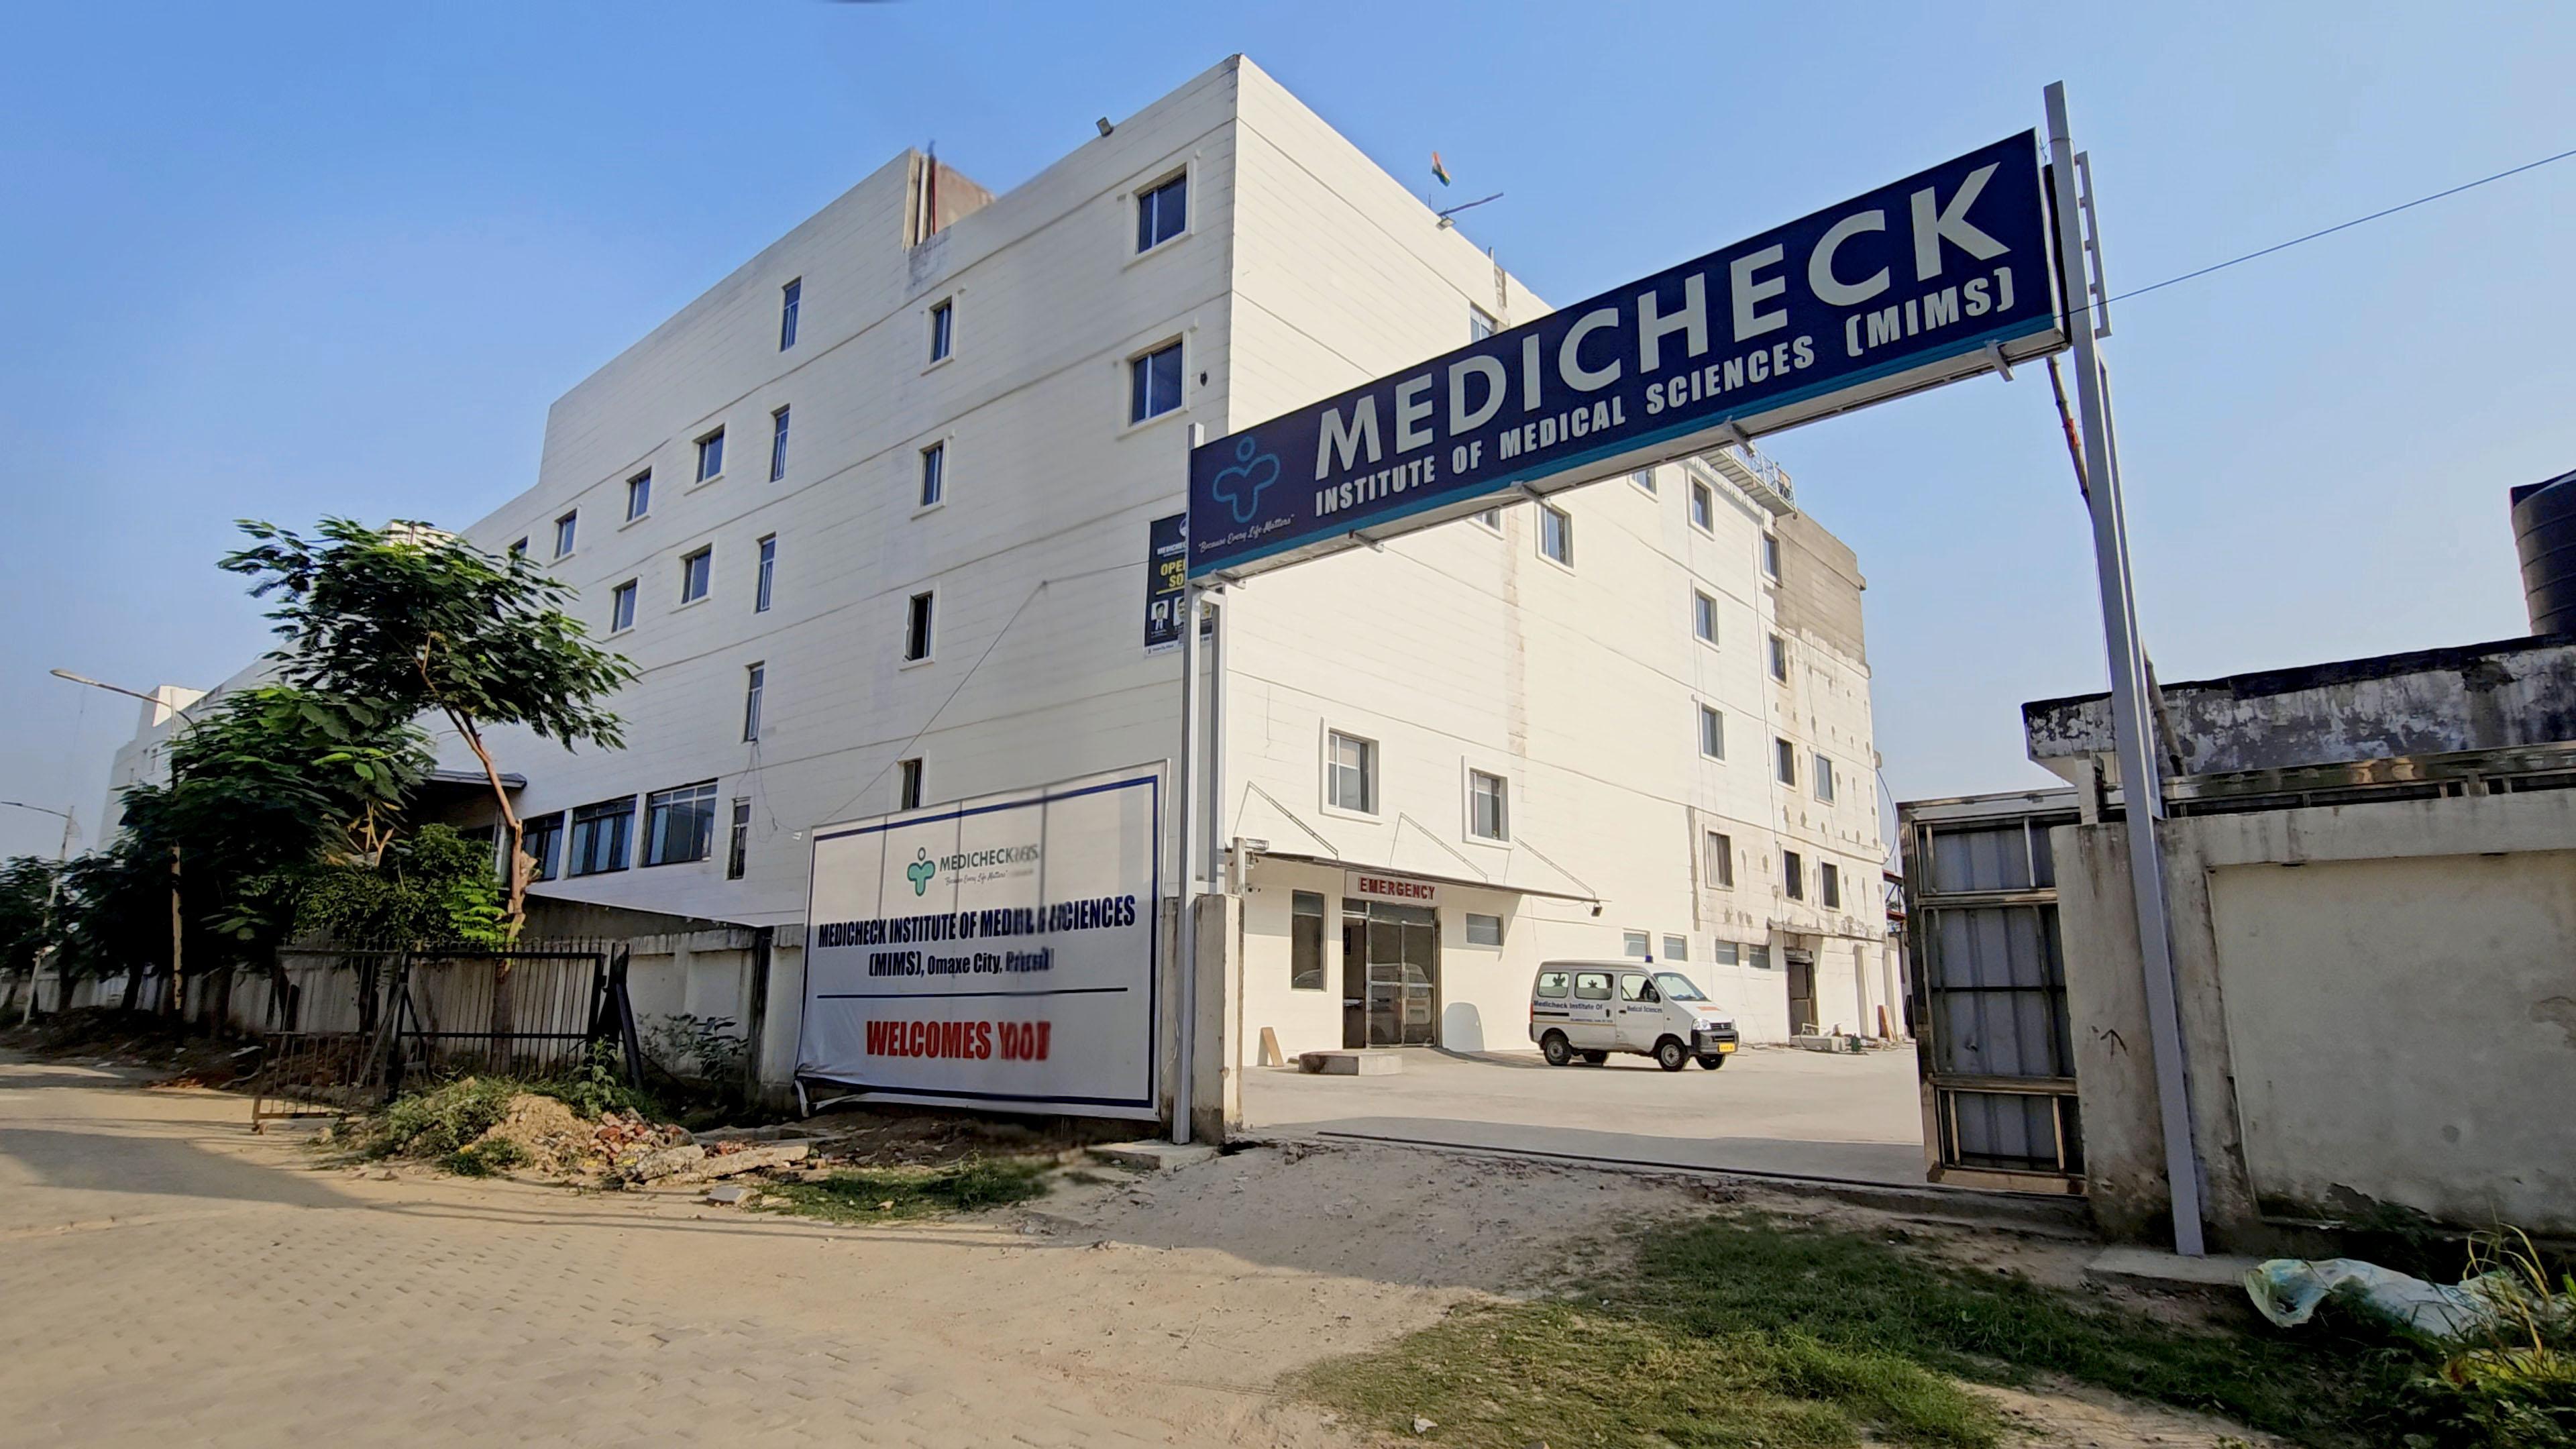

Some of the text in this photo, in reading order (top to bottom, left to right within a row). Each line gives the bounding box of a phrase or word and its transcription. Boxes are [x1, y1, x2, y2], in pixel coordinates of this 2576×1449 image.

[1315, 162, 2011, 481] MEDICHECK
[1316, 455, 1435, 517] INSTITUTE
[1452, 440, 1482, 474] OF
[1500, 396, 1625, 460] MEDICAL
[1646, 335, 1815, 415] SCIENCES
[1227, 531, 1247, 545] Every
[1169, 573, 1184, 587] SO
[1359, 877, 1436, 900] EMERGENCY
[818, 919, 887, 948] MEDICHECK
[889, 912, 957, 944] INSTITUTE
[959, 911, 977, 939] OF
[927, 955, 971, 975] Omaxe
[973, 952, 1003, 975] City,
[1534, 1000, 1568, 1009] Medicheck
[1569, 1002, 1595, 1010] Institute
[866, 1020, 991, 1060] WELCOMES
